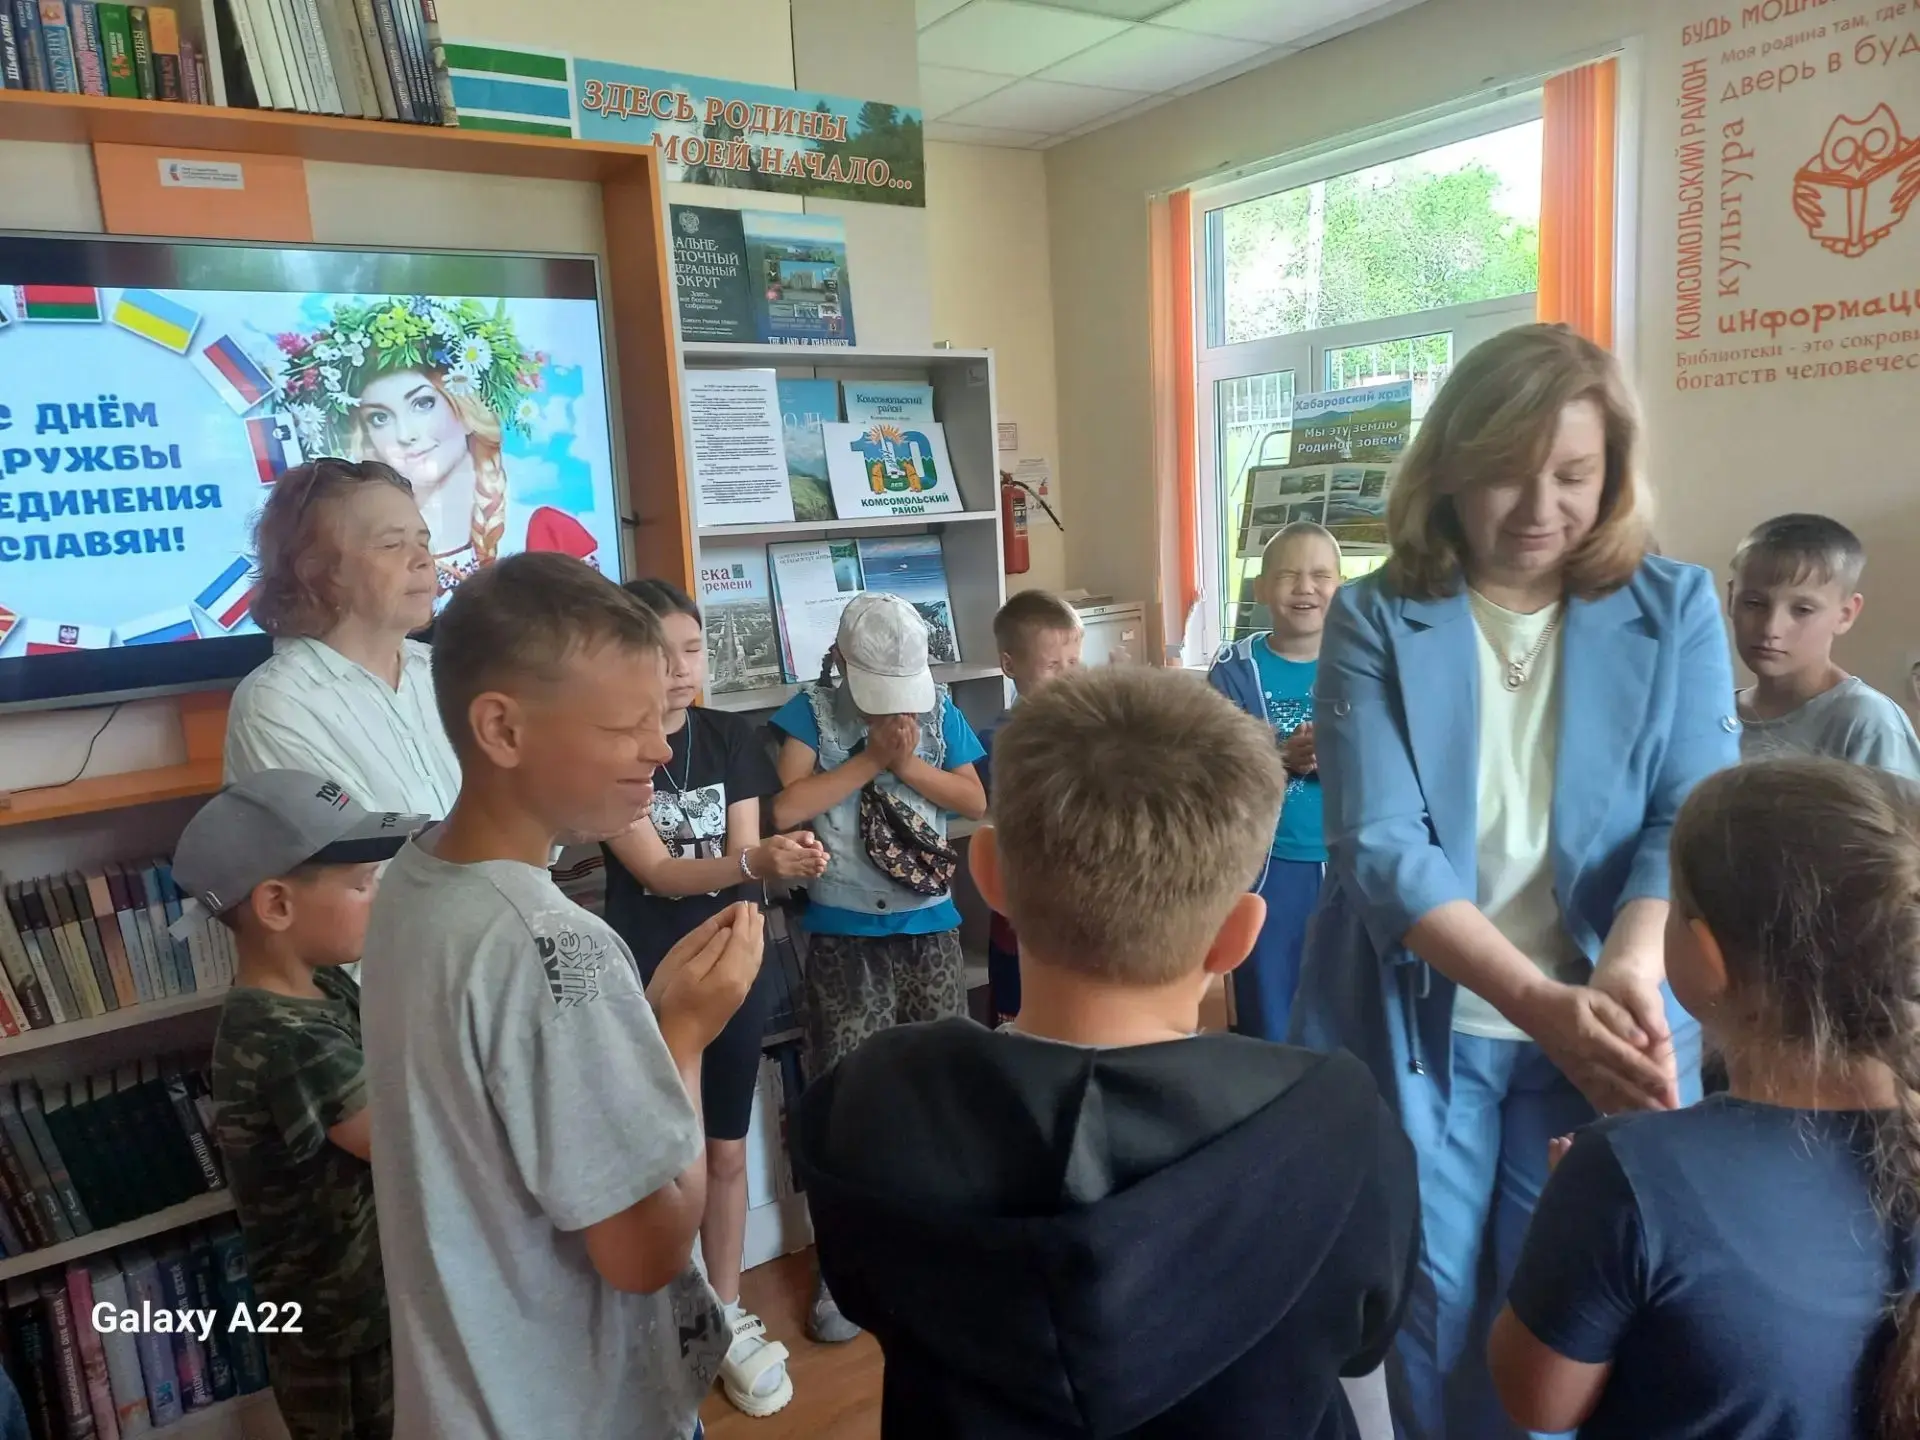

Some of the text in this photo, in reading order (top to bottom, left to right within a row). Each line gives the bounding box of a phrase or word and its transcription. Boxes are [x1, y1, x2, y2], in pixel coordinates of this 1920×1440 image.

[1682, 15, 1732, 46] БУДЬ
[1720, 46, 1756, 64] Моя
[1761, 26, 1826, 57] родина
[1875, 4, 1907, 23] где
[133, 30, 147, 64] ГРИБЫ
[1828, 51, 1842, 74] в
[581, 79, 848, 143] ЗДЕСЬ РОДИНЫ
[650, 132, 913, 190] МОЕЙ НАЧАЛО...
[1674, 57, 1708, 341] КОМСОМОЛЬСКИЙ РАЙОН
[1718, 116, 1756, 298] культура
[673, 236, 719, 251] АЛЬНЕ-
[676, 274, 721, 289] ОКРУГ
[1676, 344, 1783, 368] Библиотеки
[1803, 339, 1834, 354] это
[1676, 352, 1920, 392] богатств человечес
[877, 404, 903, 415] район
[1294, 385, 1410, 412] Хабаровский край
[35, 394, 159, 435] ДНЁМ
[1304, 420, 1398, 438] Мы эту землю
[0, 444, 182, 480] РУЖБЫ
[1297, 440, 1353, 454] Родиной
[0, 484, 222, 523] ЕДИНЕНИЯ
[861, 492, 949, 507] КОМСОМОЛЬСКИЙ
[891, 504, 925, 514] РАЙОН
[0, 526, 185, 562] СЛАВЯН!
[702, 579, 752, 594] ремени
